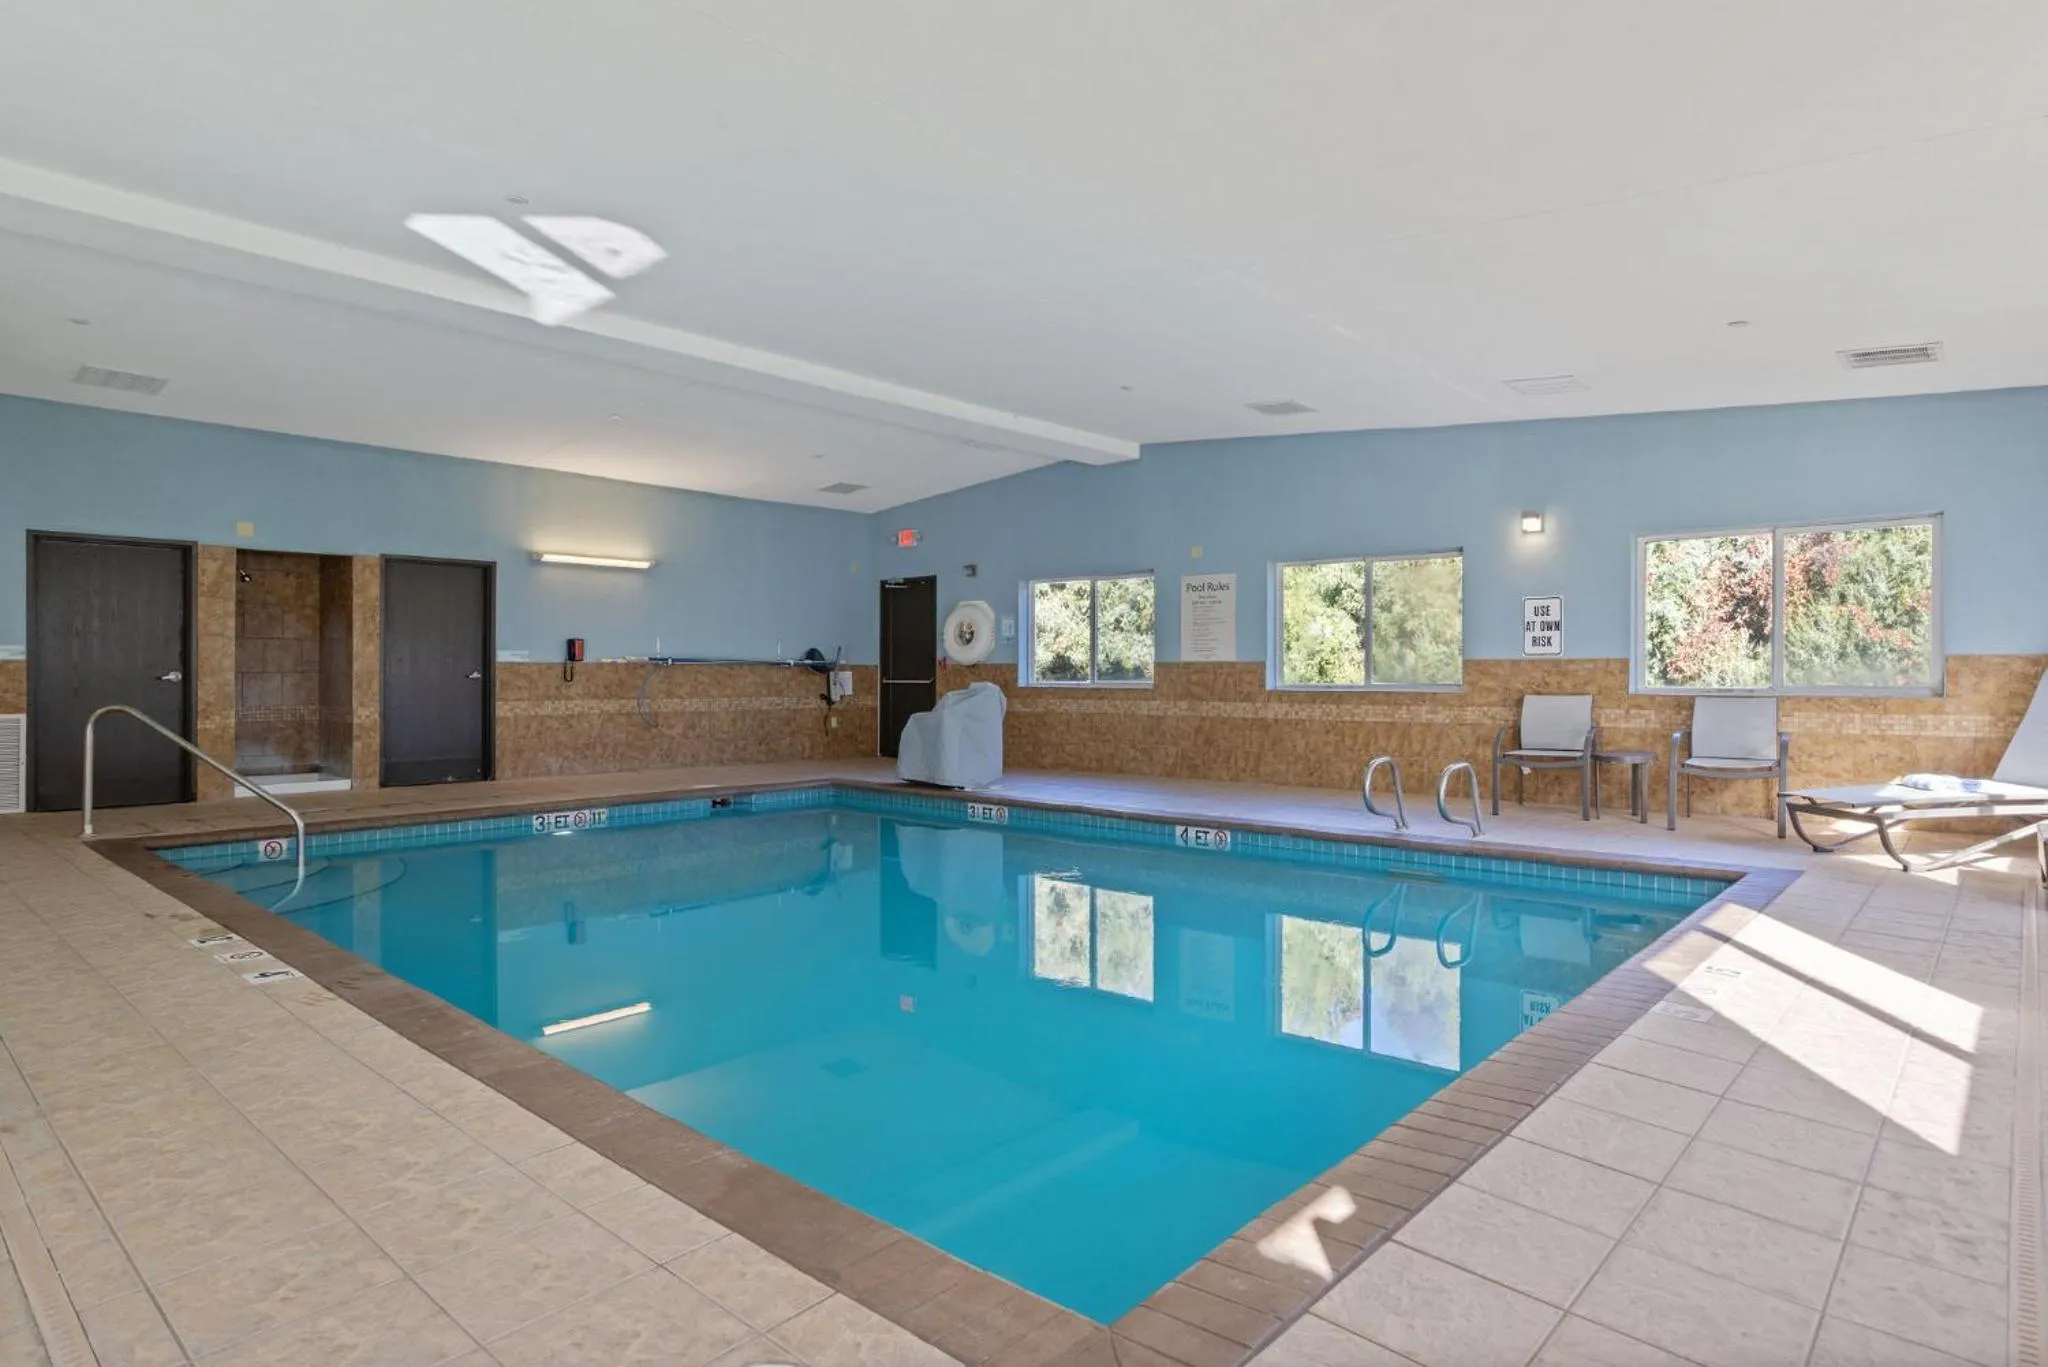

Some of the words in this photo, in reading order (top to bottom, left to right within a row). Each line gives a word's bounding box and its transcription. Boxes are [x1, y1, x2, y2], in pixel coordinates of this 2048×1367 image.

[1185, 582, 1205, 593] Pool
[1206, 581, 1230, 592] Rules
[1534, 605, 1551, 616] USE
[1525, 620, 1536, 632] AT
[1539, 620, 1560, 632] OWN
[1531, 636, 1552, 647] RISK
